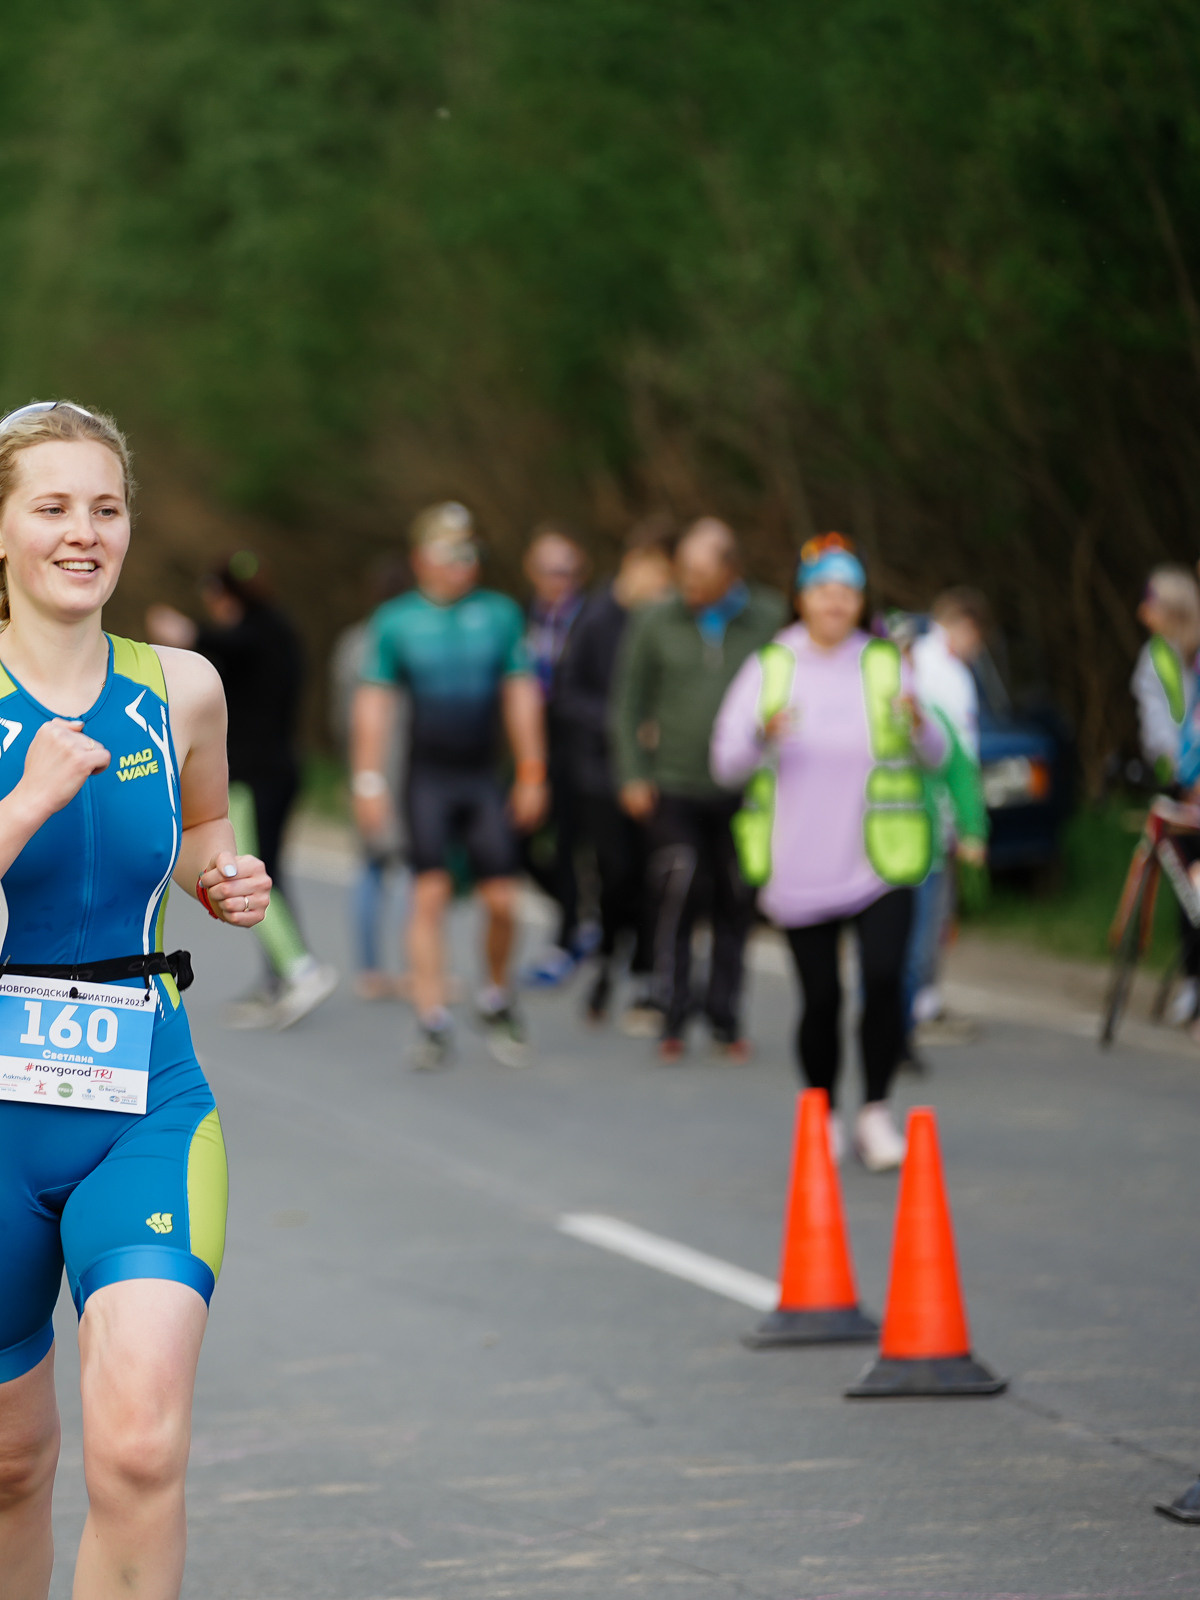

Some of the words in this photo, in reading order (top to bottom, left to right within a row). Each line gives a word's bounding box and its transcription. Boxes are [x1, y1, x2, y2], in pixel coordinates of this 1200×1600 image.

[120, 748, 153, 768] MAD
[116, 760, 159, 782] WAVE
[0, 984, 76, 999] НОВГОРОДСКИ
[125, 998, 145, 1007] 2023
[20, 1000, 119, 1053] 160
[42, 1049, 94, 1064] Светлана
